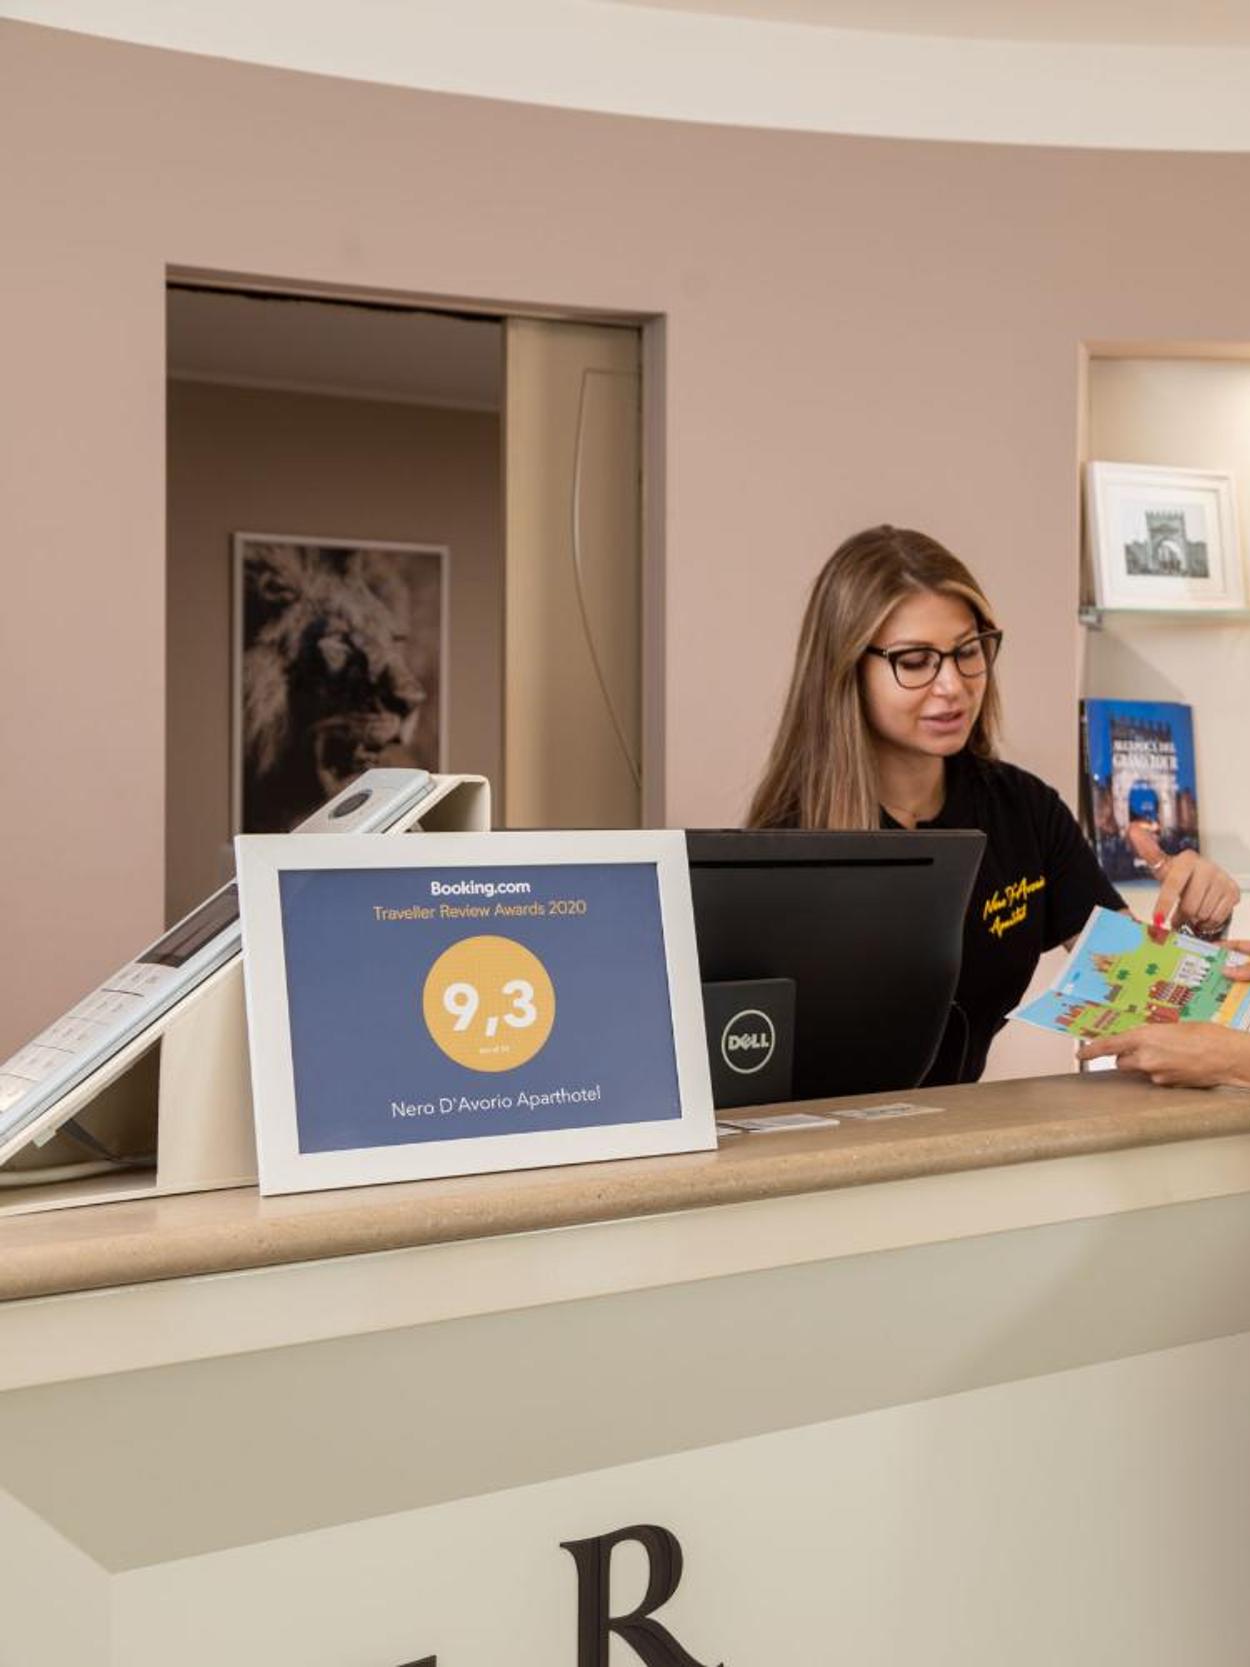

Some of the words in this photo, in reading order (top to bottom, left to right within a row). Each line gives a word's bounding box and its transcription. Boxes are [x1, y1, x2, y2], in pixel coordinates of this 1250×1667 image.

[430, 880, 531, 897] Booking.com
[373, 905, 435, 921] Traveller
[440, 904, 490, 918] Review
[495, 901, 545, 917] Awards
[549, 899, 587, 915] 2020
[443, 979, 537, 1037] 9,3
[728, 1032, 770, 1051] DELL
[391, 1101, 435, 1118] Nero
[439, 1095, 513, 1113] D'Avorio
[516, 1085, 601, 1111] Aparthotel
[559, 1524, 724, 1667] R
